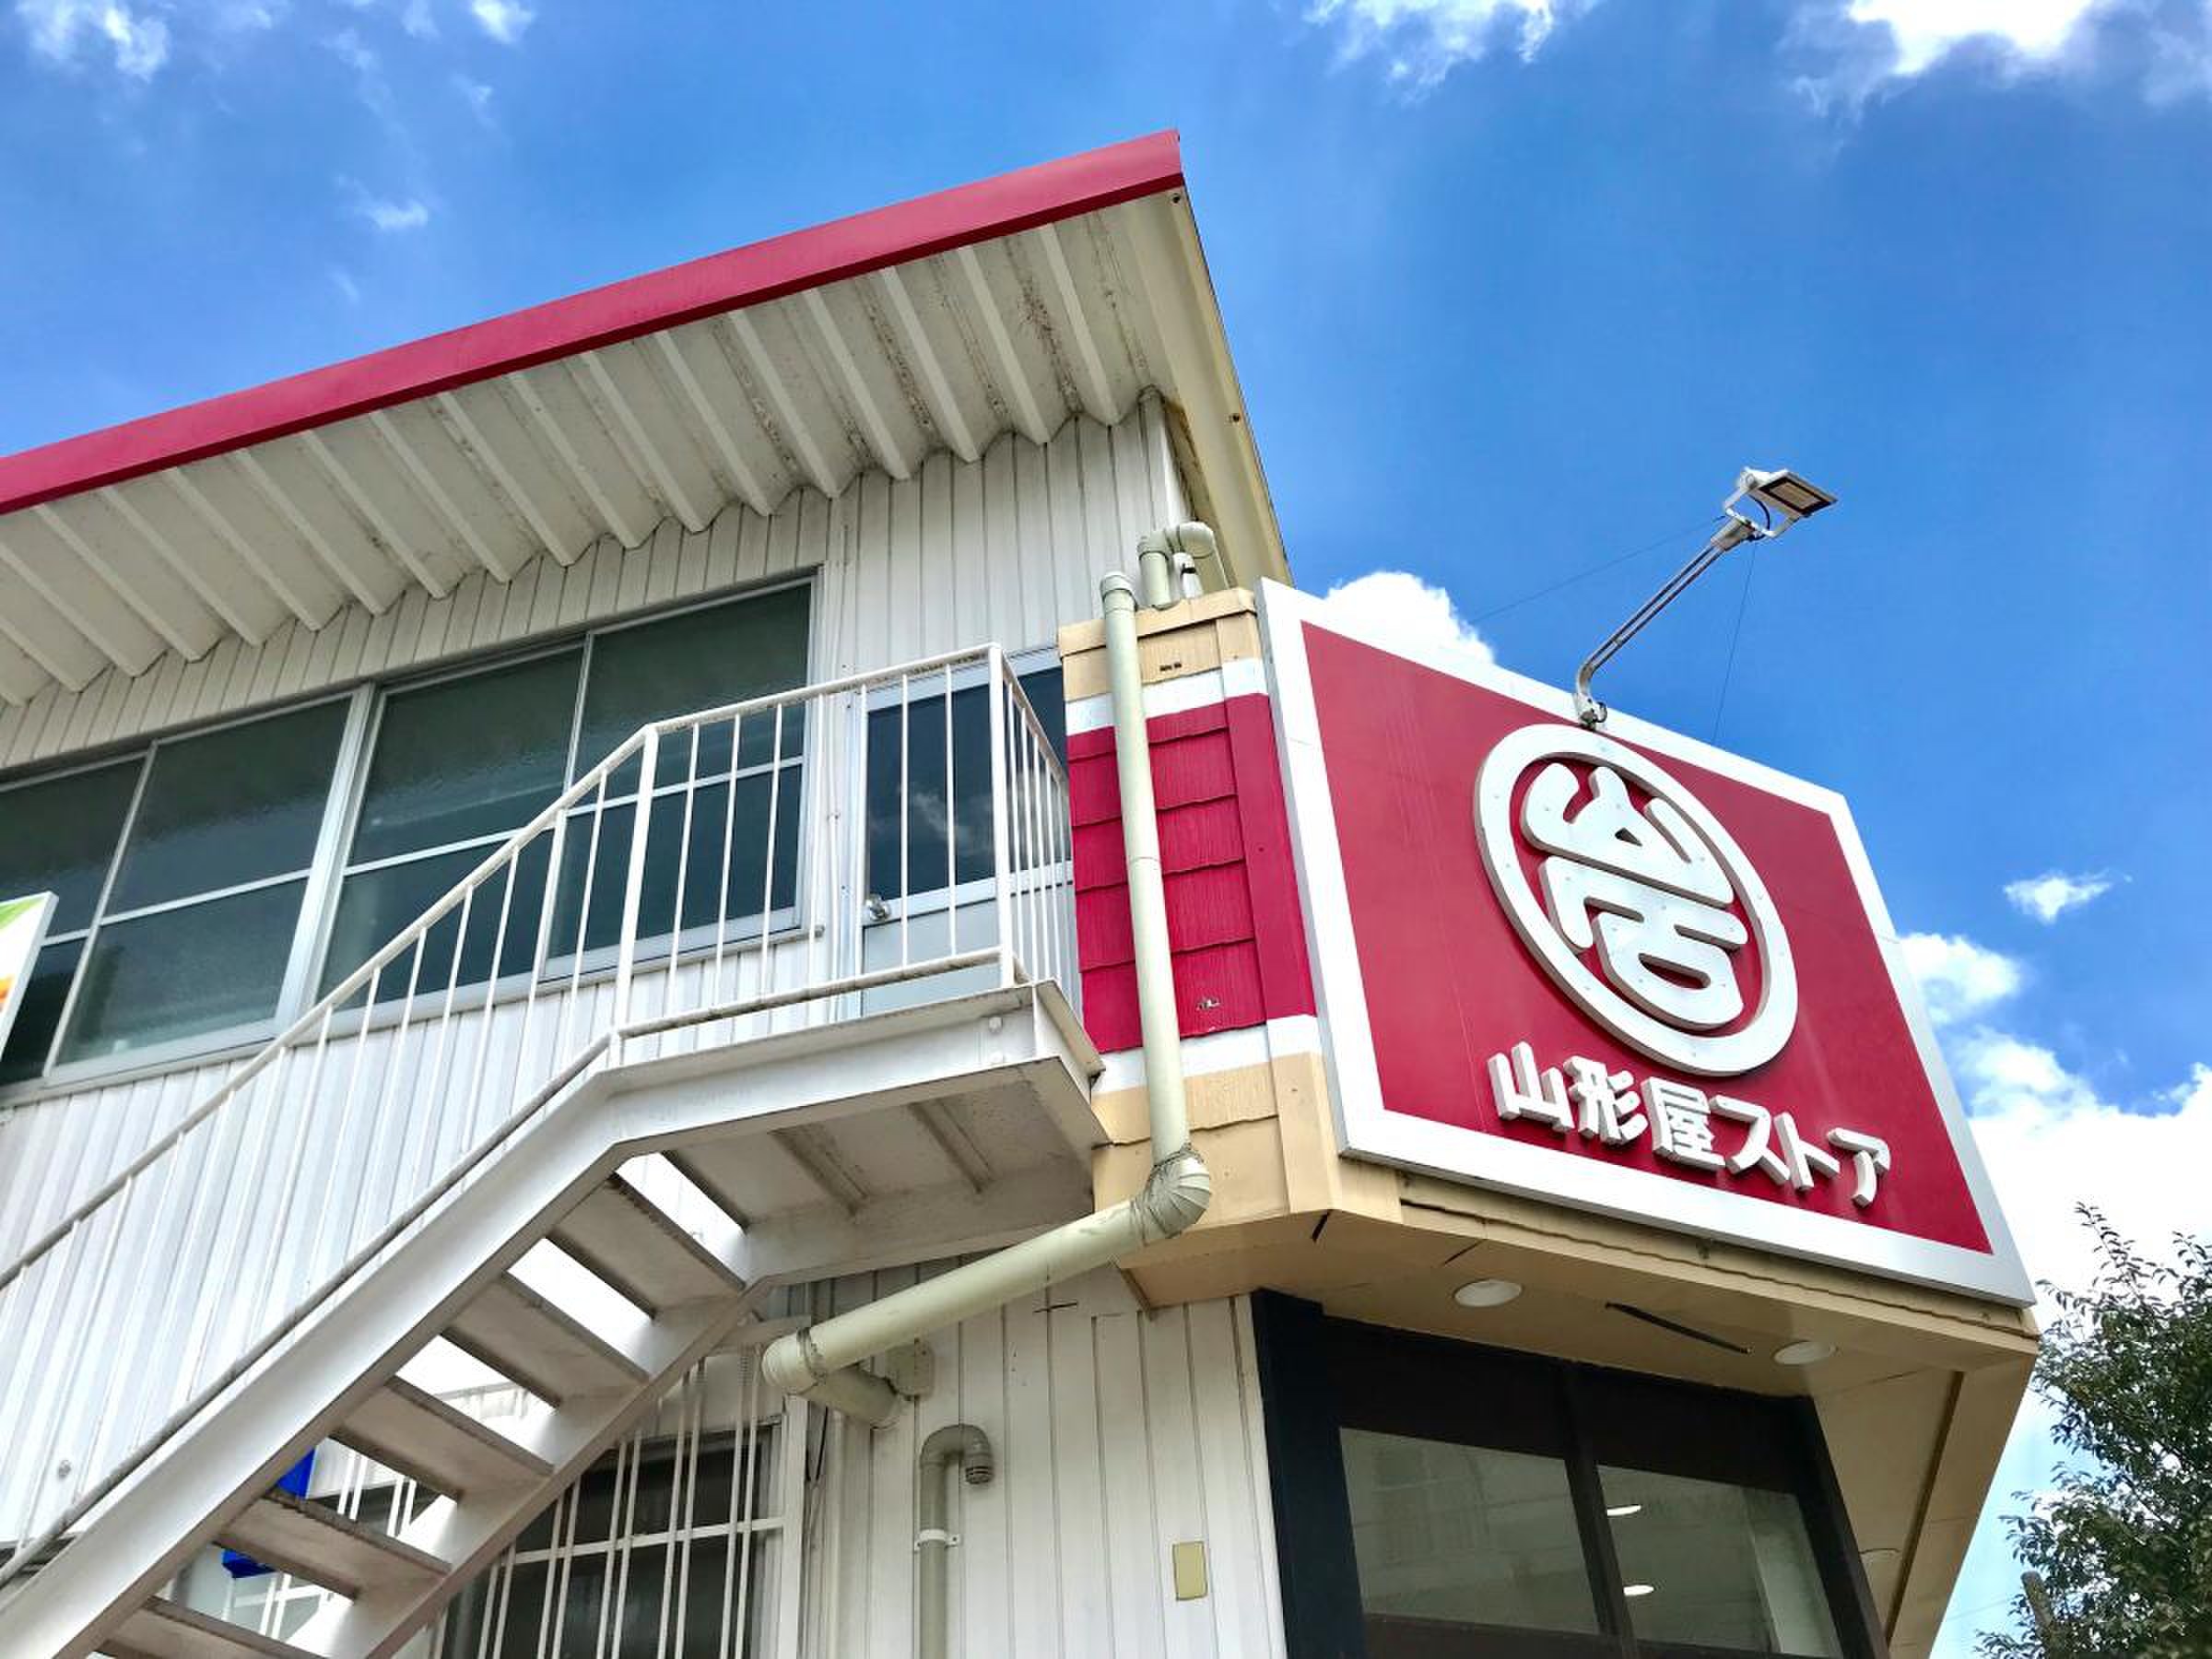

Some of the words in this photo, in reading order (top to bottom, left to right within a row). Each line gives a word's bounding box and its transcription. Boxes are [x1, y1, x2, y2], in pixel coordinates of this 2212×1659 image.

[1487, 1041, 1892, 1208] 山形屋ストア
